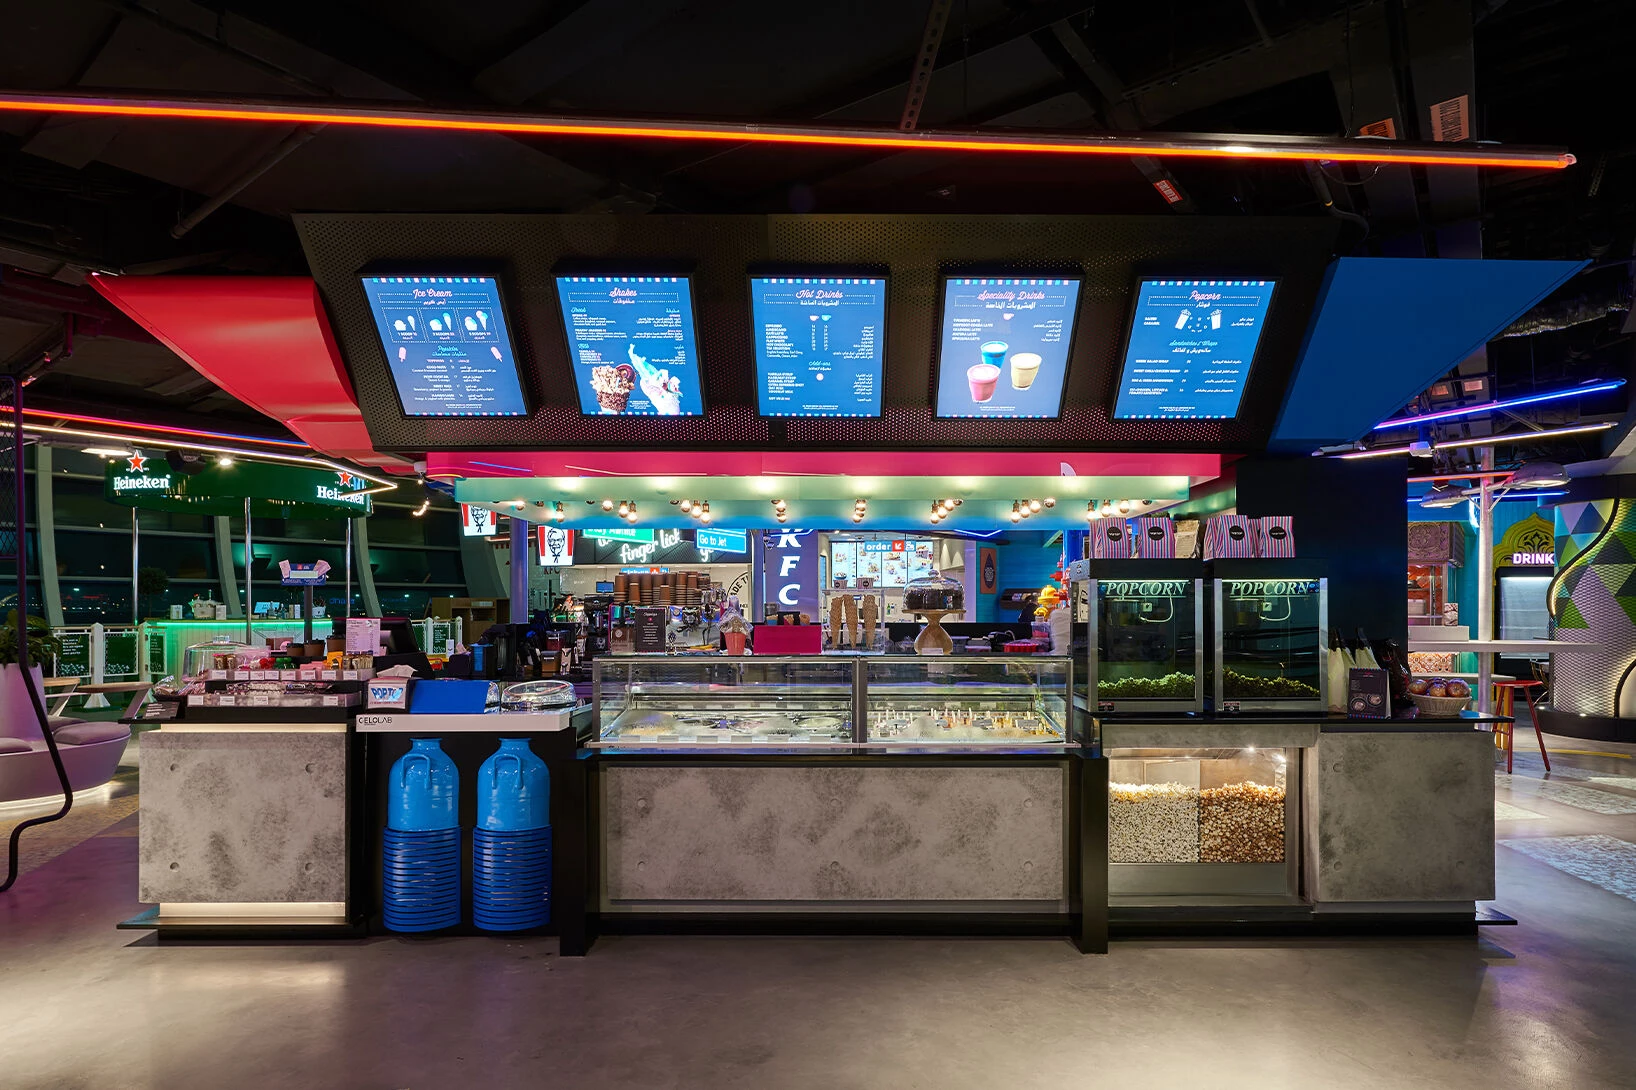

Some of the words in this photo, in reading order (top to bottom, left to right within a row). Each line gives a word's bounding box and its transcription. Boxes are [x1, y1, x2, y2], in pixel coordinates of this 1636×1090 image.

[413, 288, 426, 299] Ice
[427, 288, 453, 297] Cream
[609, 287, 637, 297] Shakes
[796, 289, 815, 298] Hot
[815, 289, 844, 298] Drinks
[1017, 290, 1046, 300] Drinks
[1189, 290, 1221, 301] Popcorn
[113, 474, 171, 490] Heineken
[700, 534, 708, 545] Go
[710, 536, 717, 546] to
[717, 537, 727, 547] Jet
[866, 542, 891, 551] order
[620, 543, 658, 563] finger
[1513, 552, 1555, 565] DRINK
[1106, 582, 1187, 595] POPCORN
[1230, 582, 1309, 595] POPCORN
